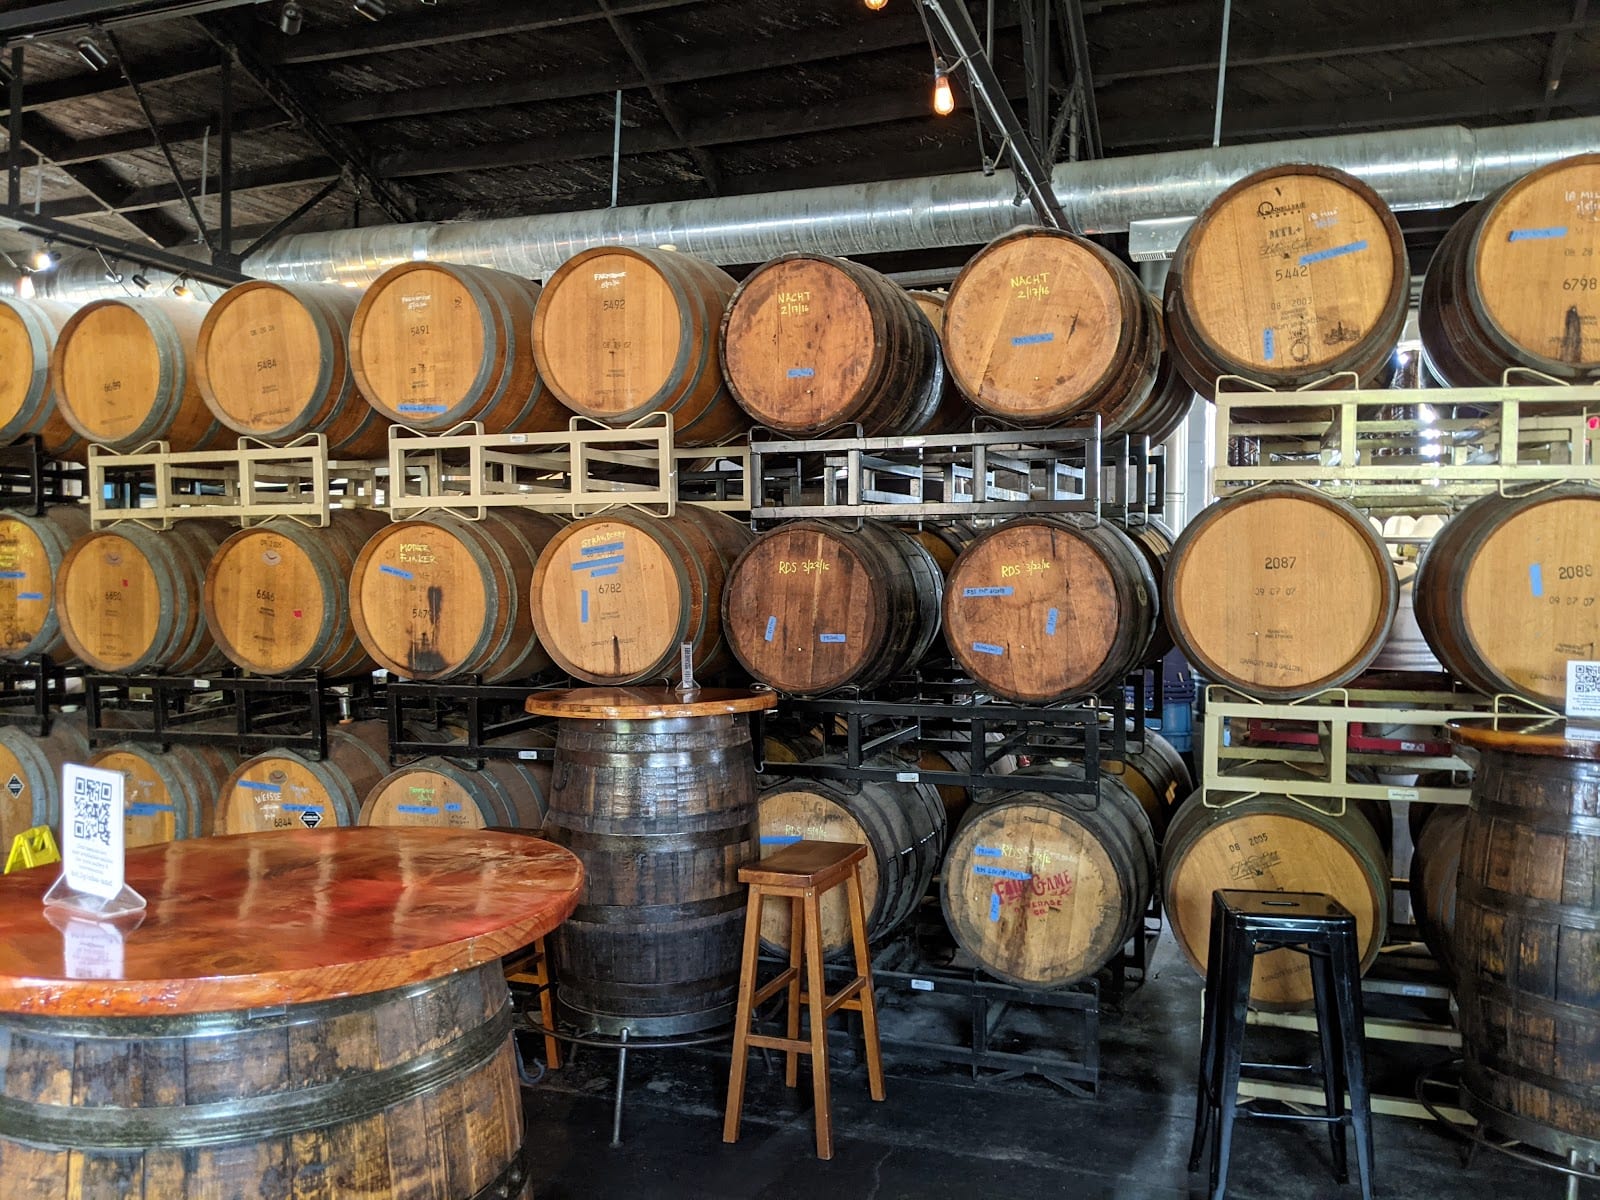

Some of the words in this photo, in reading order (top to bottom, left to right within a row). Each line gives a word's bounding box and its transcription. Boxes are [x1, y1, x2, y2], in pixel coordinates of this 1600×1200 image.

[1010, 272, 1051, 288] NACHT
[1275, 265, 1309, 282] 5442
[1562, 277, 1598, 292] 6798
[778, 291, 811, 304] NACHT
[1018, 284, 1050, 301] 2/17/16
[602, 299, 626, 312] 5492
[778, 560, 798, 574] RDS
[1264, 556, 1297, 570] 2087
[1001, 565, 1021, 578] RDS
[598, 583, 622, 594] 6782
[1031, 869, 1072, 896] GAME
